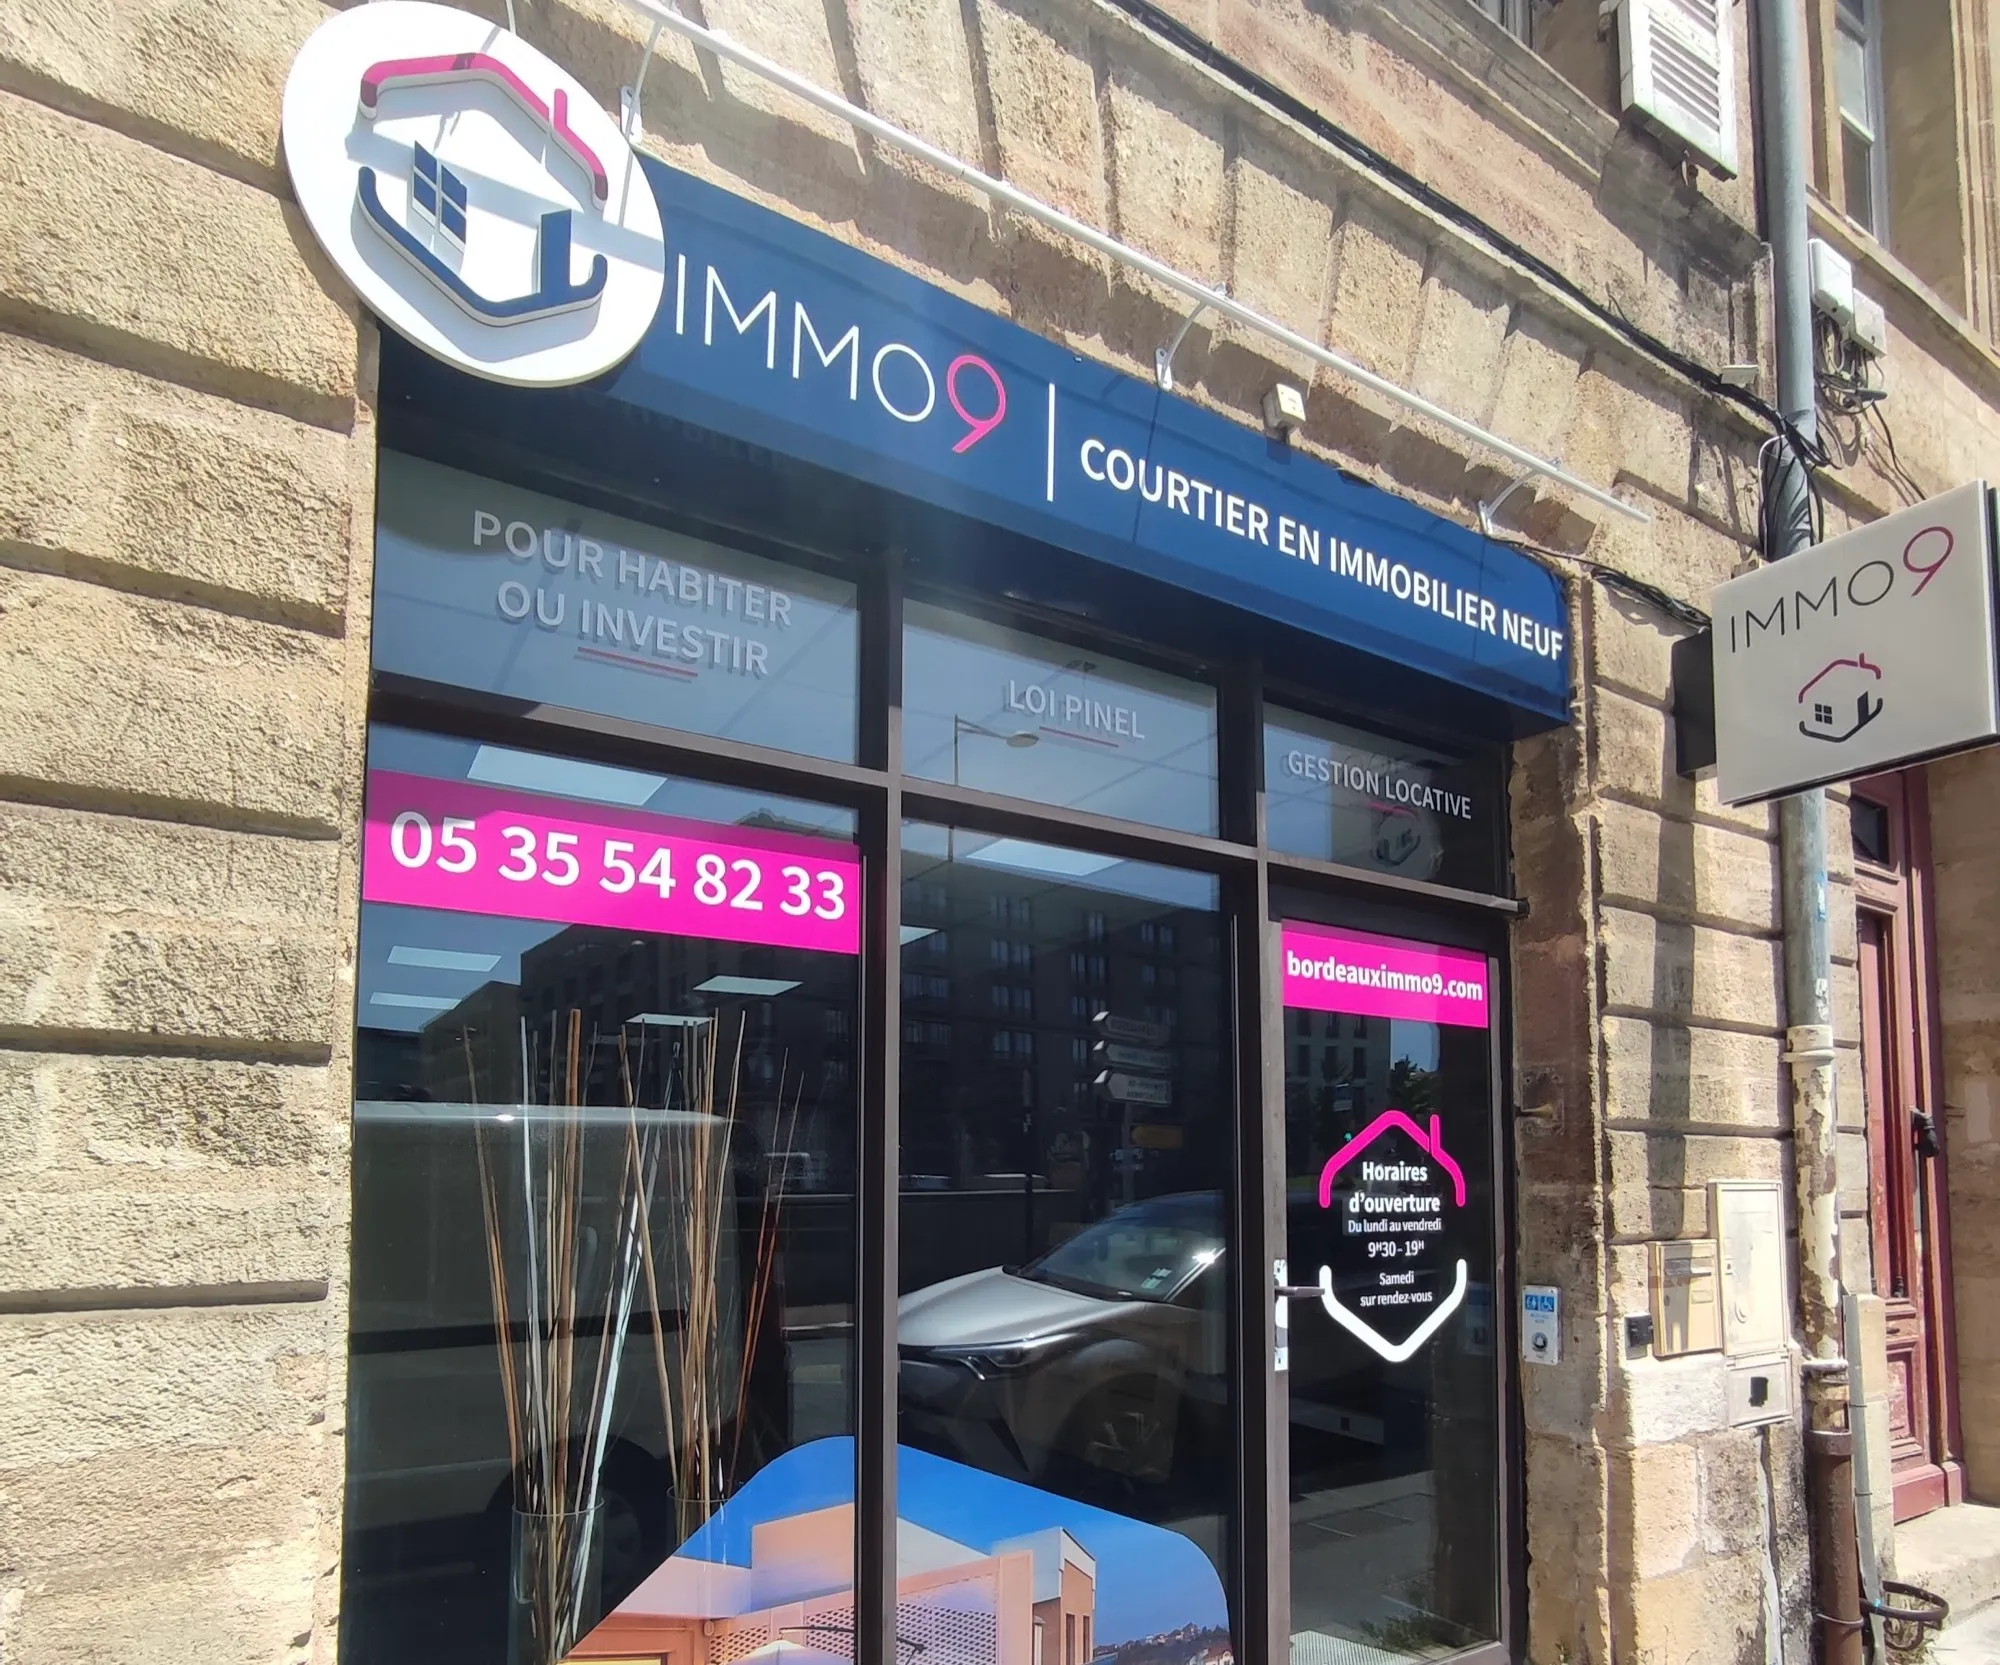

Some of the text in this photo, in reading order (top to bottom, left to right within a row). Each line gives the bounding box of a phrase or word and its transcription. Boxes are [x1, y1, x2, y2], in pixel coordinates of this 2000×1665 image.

[676, 254, 1006, 453] IMMO9
[473, 510, 792, 626] POUR HABITER
[1080, 439, 1563, 661] COURTIER EN IMMOBILIER NEUF
[1731, 526, 1954, 653] IMMO9
[498, 581, 768, 675] OU INVESTIR
[1009, 680, 1145, 740] LOI PINEL
[1287, 750, 1472, 819] GESTION LOCATIVE
[390, 811, 845, 920] 05 35 54 82 33
[1287, 950, 1483, 1000] bordeauximmo9.com
[1349, 1192, 1441, 1213] d’ouverture
[1362, 1161, 1428, 1182] Horaires
[1348, 1218, 1442, 1232] Du lundi au vendredi
[1360, 1291, 1433, 1307] sur rendez-vous
[1379, 1271, 1415, 1286] Samedi
